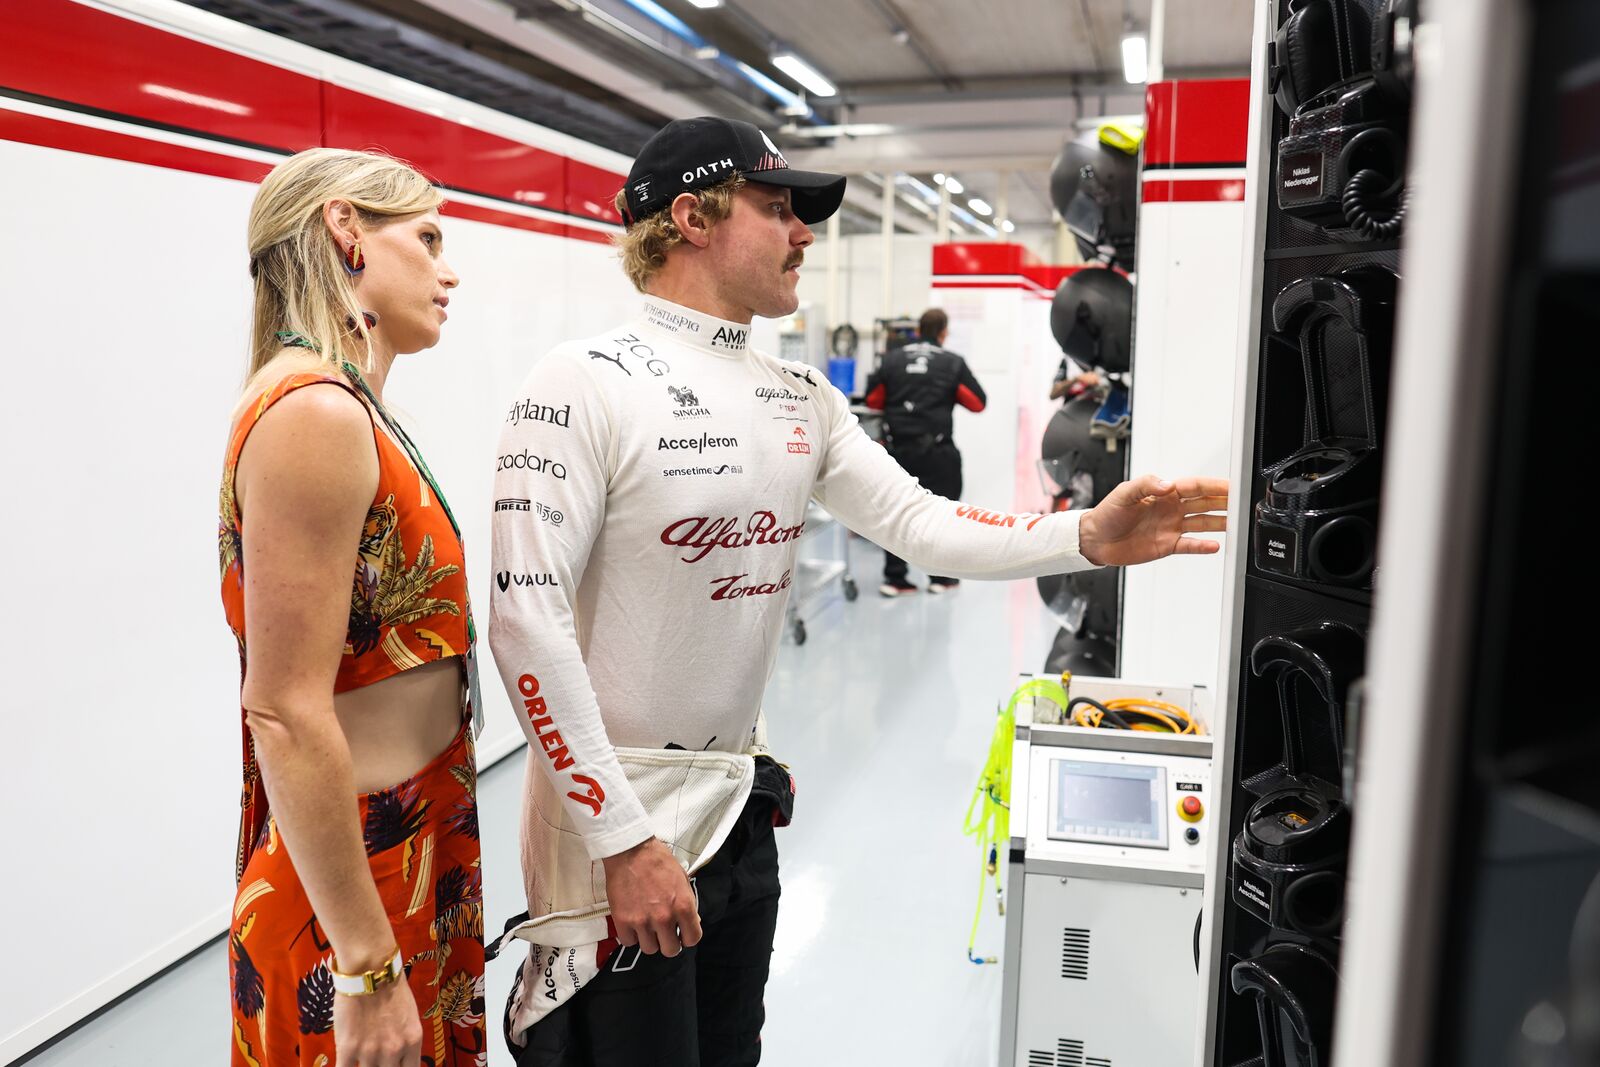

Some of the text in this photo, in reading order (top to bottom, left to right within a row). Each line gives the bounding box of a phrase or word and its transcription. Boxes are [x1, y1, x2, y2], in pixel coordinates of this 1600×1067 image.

[682, 158, 733, 183] OATH
[1293, 166, 1311, 177] Niklas
[1284, 175, 1319, 188] Niederegger
[712, 326, 747, 345] AMX
[614, 333, 670, 377] ZCG
[756, 387, 780, 402] Alfa
[506, 398, 571, 428] Hyland
[672, 408, 711, 418] SINGHA
[658, 432, 738, 454] Accelleron
[497, 448, 567, 480] zadara
[663, 467, 712, 476] sensetime
[495, 498, 531, 512] PIRELLI
[956, 506, 1017, 528] ORLEN
[660, 516, 743, 563] Alfa
[1268, 540, 1286, 550] Adrian
[1268, 548, 1285, 558] Sucak
[513, 574, 558, 587] VAUL
[709, 569, 792, 600] Tonale
[518, 674, 576, 772] ORLEN
[566, 948, 580, 992] ensetime
